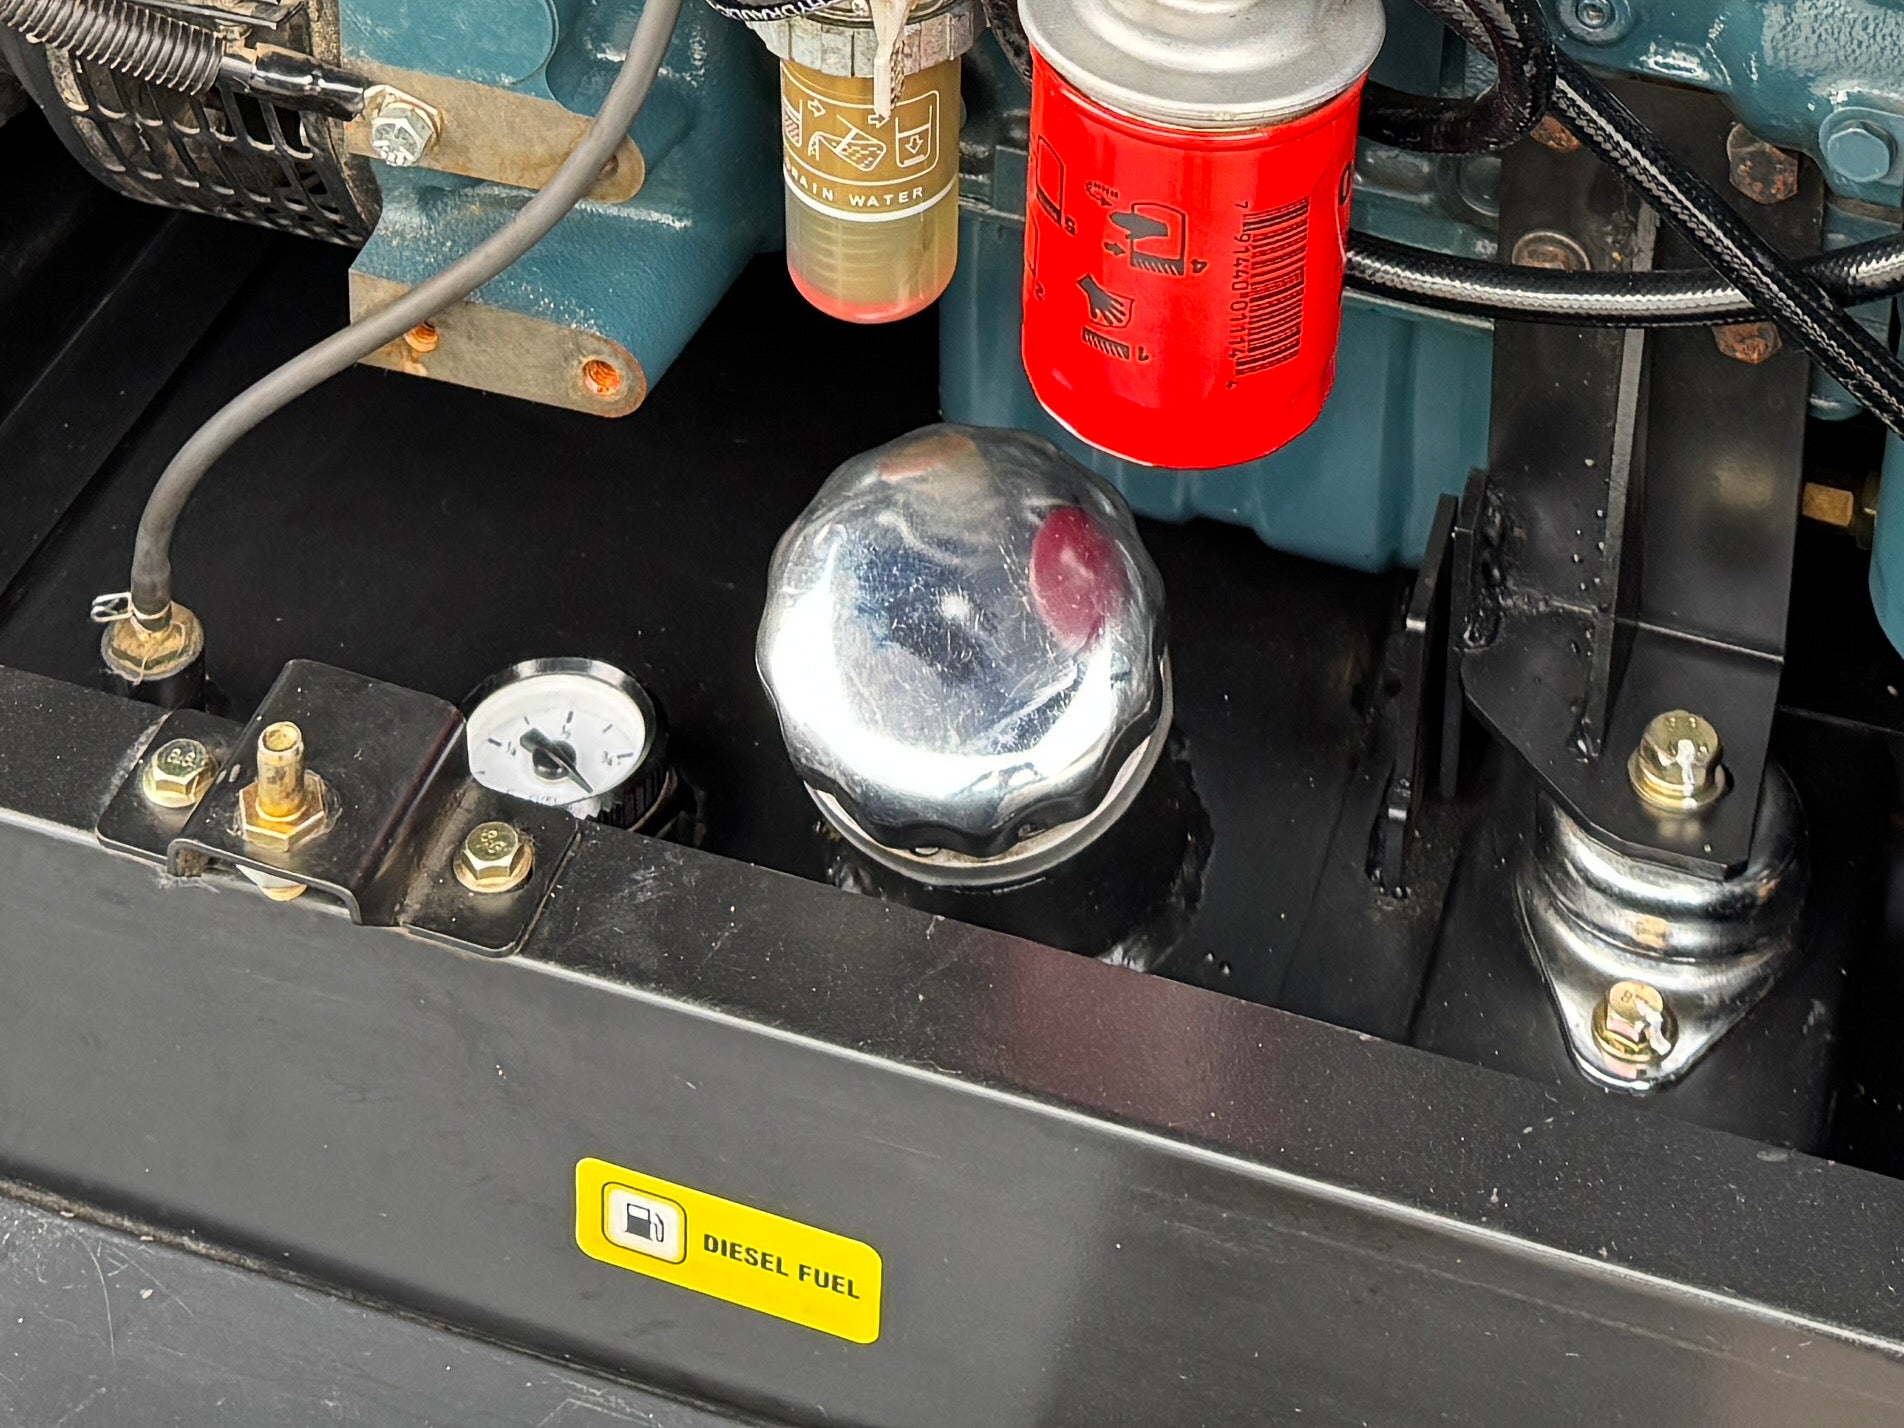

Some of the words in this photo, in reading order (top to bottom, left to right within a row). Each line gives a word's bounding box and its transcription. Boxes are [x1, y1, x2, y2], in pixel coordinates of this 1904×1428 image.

[849, 187, 924, 207] WATER
[1232, 233, 1251, 292] 91440
[1227, 299, 1249, 359] 01114
[703, 1233, 789, 1278] DIESEL
[798, 1264, 861, 1300] FUEL
